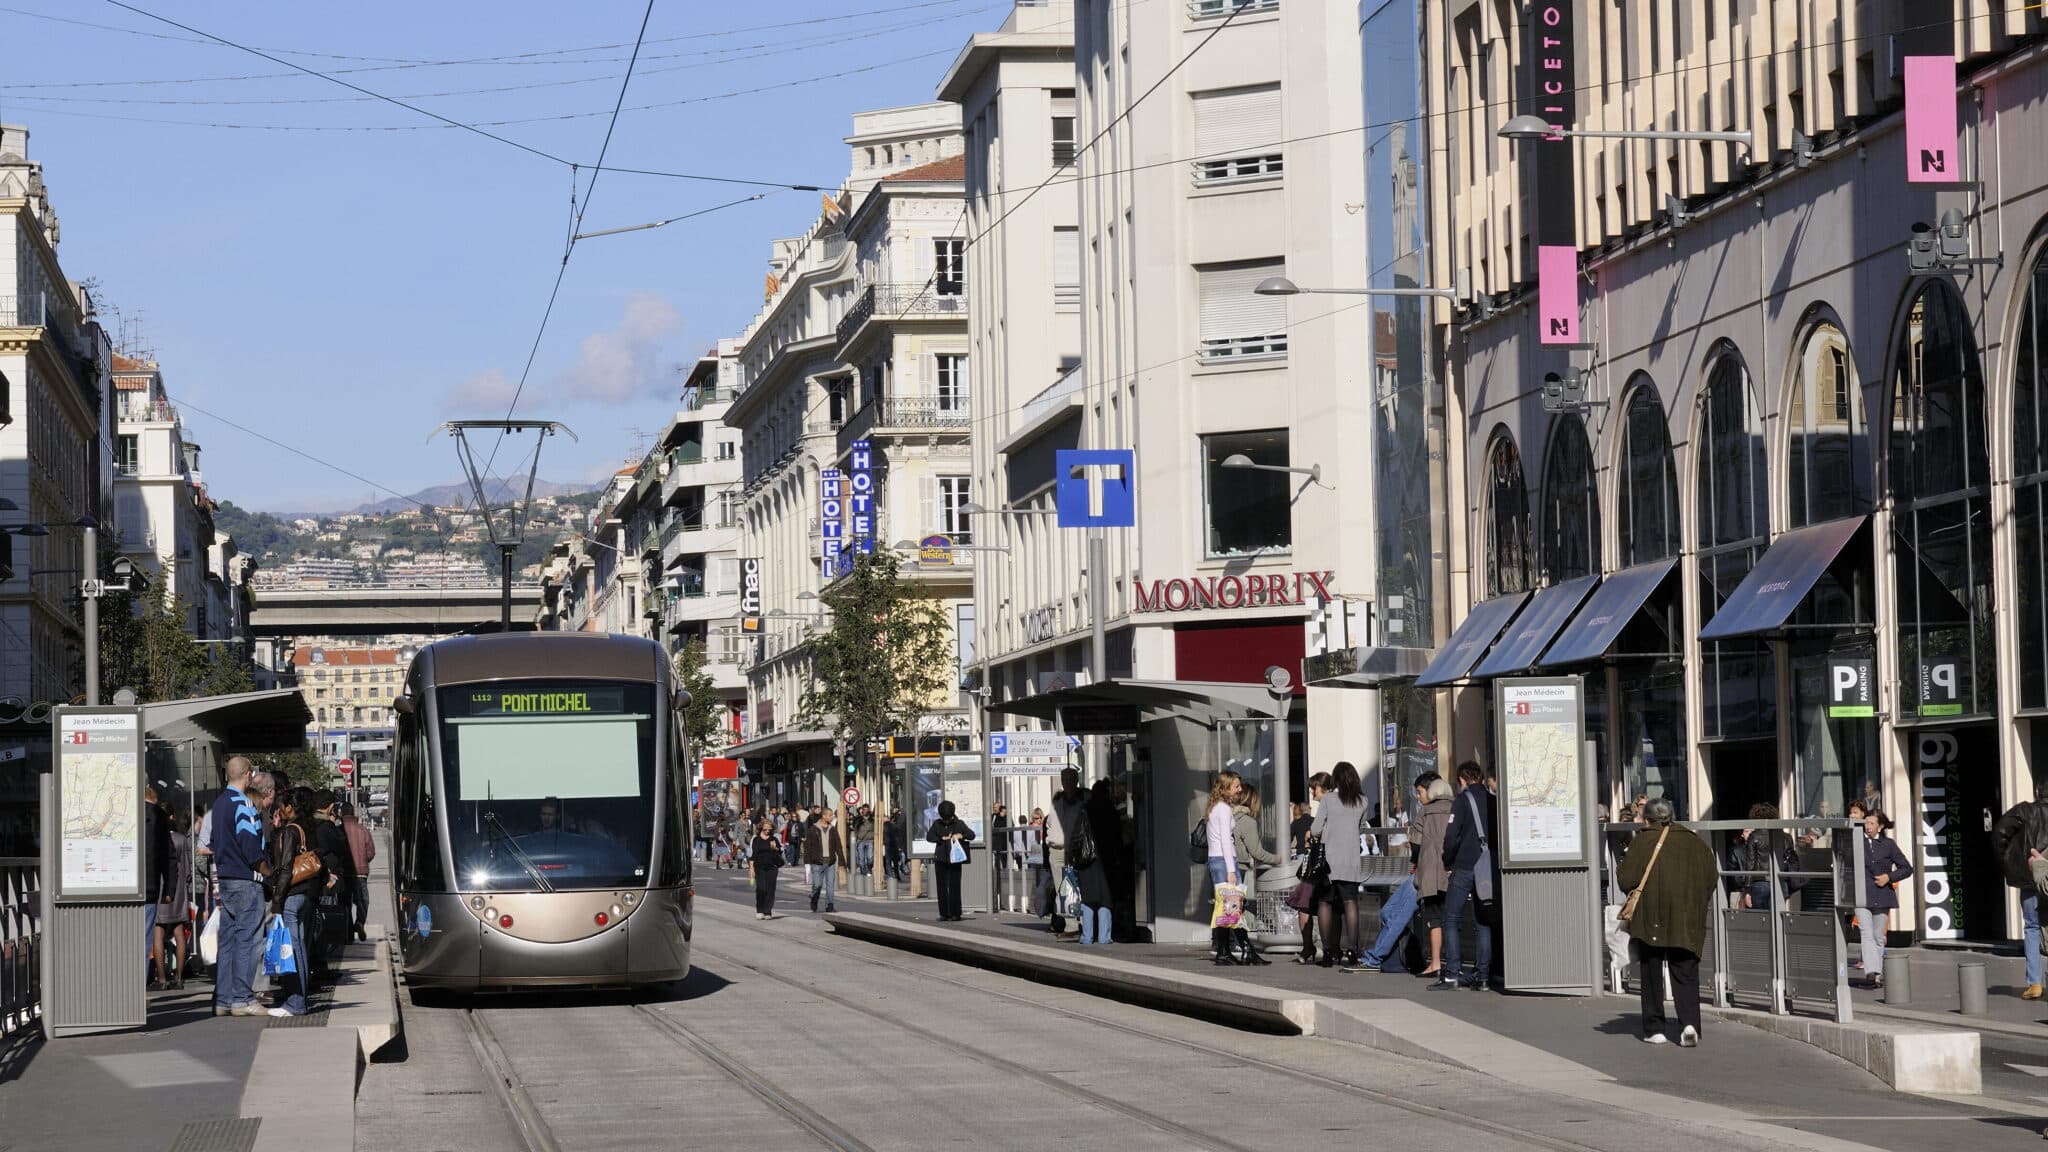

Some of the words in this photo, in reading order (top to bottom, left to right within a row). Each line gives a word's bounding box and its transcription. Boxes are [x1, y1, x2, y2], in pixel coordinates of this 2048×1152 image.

[853, 452, 870, 554] HOTEL
[1070, 464, 1126, 517] T
[823, 481, 840, 577] HOTEL
[921, 551, 950, 560] Western
[741, 559, 759, 613] fnac
[1133, 570, 1333, 612] MONOPRIX
[1516, 689, 1533, 697] Jean
[1833, 665, 1858, 701] P
[1859, 665, 1868, 701] PARKING
[501, 694, 539, 712] PONT
[540, 693, 591, 711] MICHEL
[1520, 704, 1526, 713] 1
[77, 733, 83, 743] 1
[991, 737, 1004, 754] P
[1029, 738, 1052, 746] Etoile
[1012, 766, 1039, 774] Docteur
[1918, 732, 1964, 939] parking
[1950, 887, 1964, 929] accès
